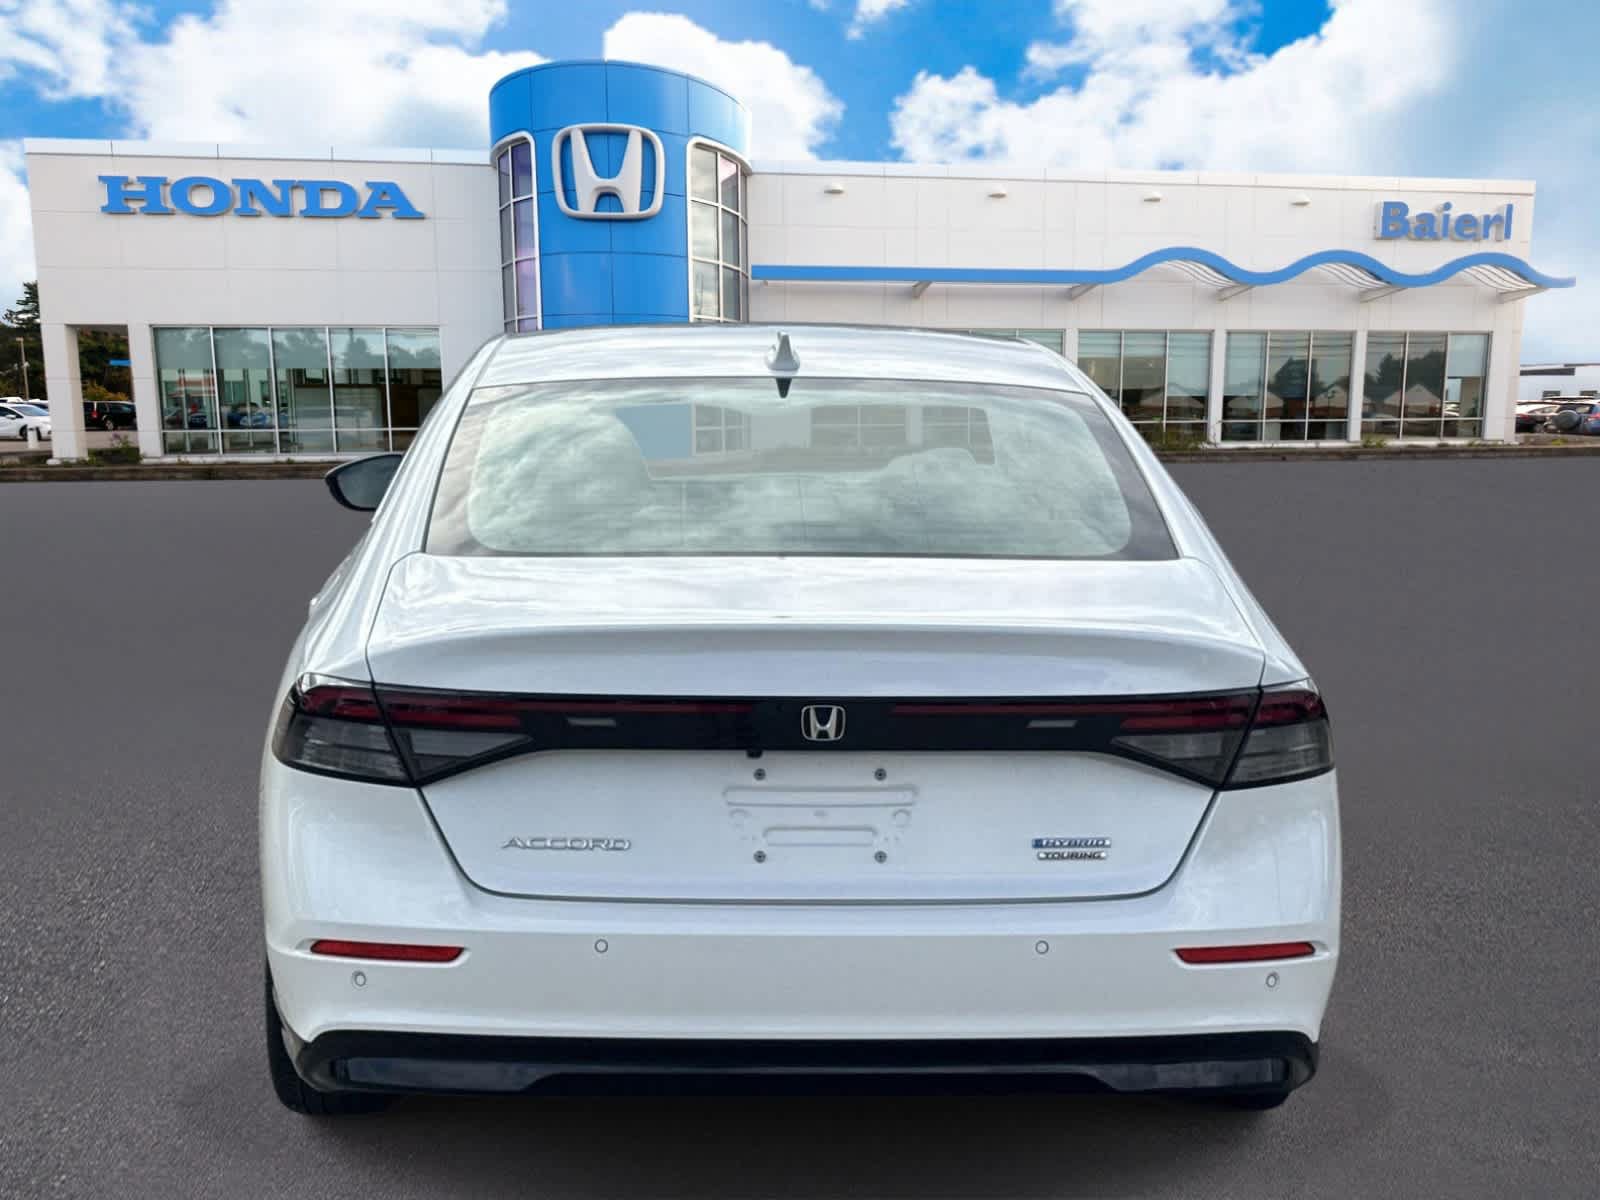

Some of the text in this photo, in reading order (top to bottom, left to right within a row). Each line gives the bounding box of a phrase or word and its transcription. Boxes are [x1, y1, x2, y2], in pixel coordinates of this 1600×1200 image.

[98, 175, 426, 219] HONDA
[1379, 200, 1514, 241] Baierl
[502, 836, 632, 851] ACCORD
[1042, 850, 1103, 861] TOURING
